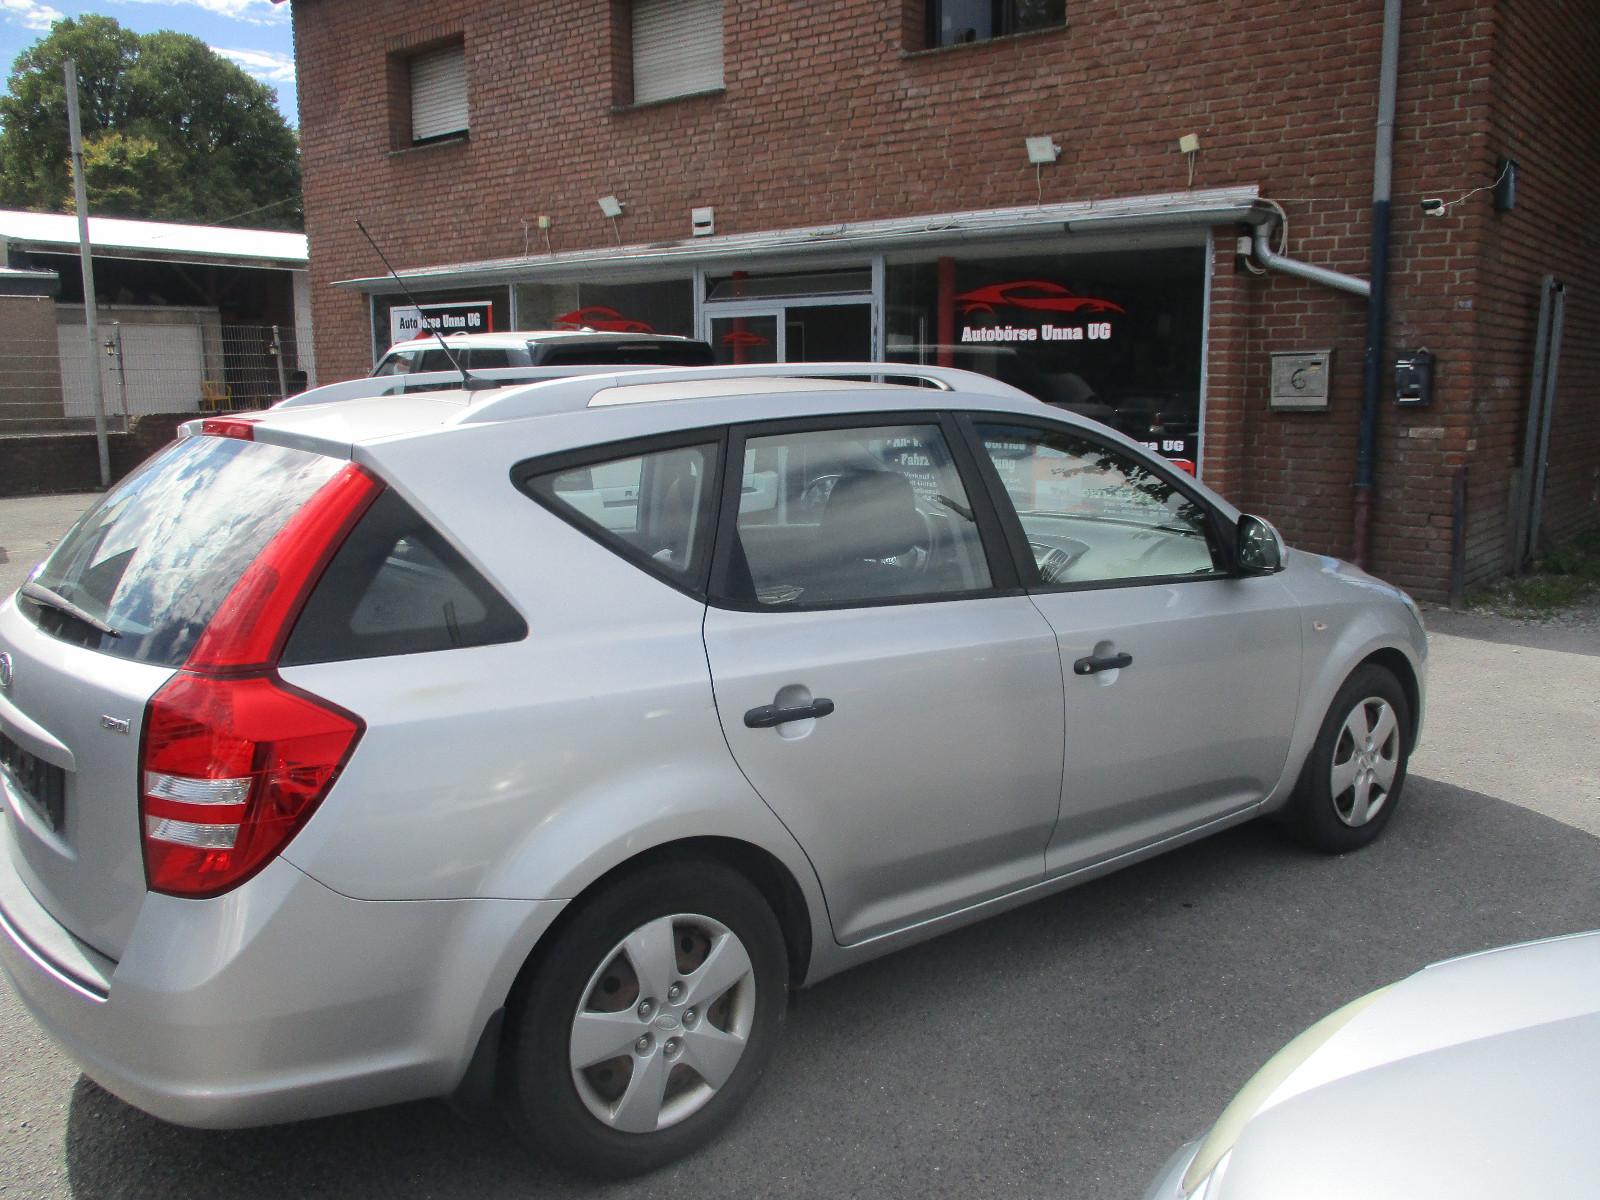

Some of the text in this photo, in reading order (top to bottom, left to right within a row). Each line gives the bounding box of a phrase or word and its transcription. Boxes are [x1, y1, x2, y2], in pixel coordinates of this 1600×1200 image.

[442, 314, 466, 328] Unna
[467, 312, 481, 326] UG
[961, 322, 1112, 342] Autobörse Unna UG
[1162, 439, 1185, 451] UG
